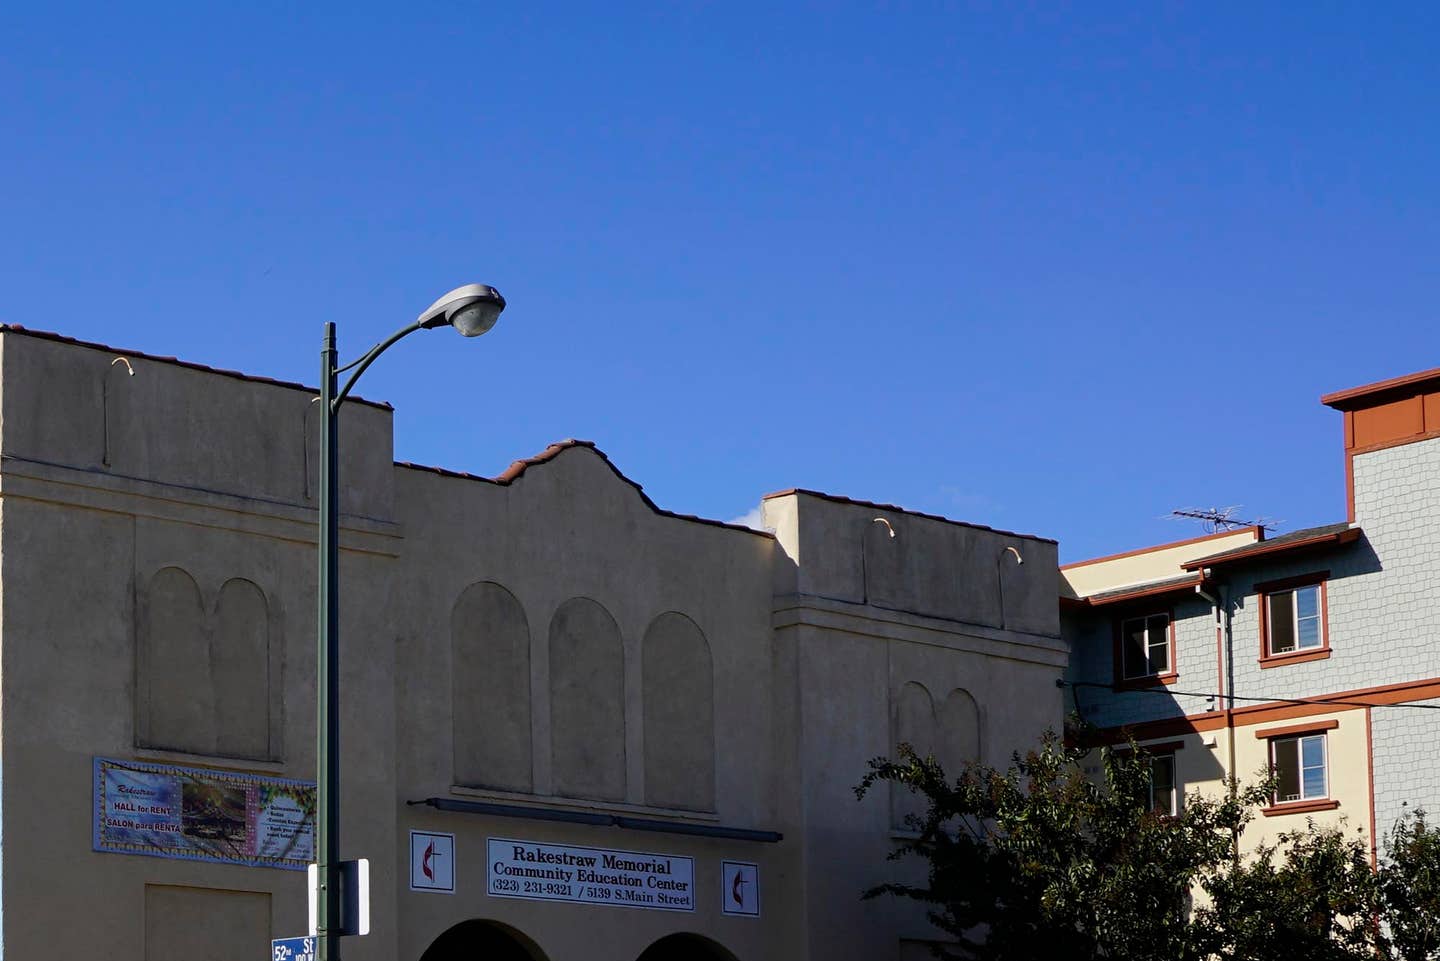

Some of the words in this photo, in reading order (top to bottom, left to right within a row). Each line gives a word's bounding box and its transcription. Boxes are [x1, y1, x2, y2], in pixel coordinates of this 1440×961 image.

[114, 802, 135, 812] HALL
[138, 805, 149, 813] for
[150, 806, 171, 815] RENT
[107, 818, 134, 828] SALON
[135, 822, 153, 831] para
[154, 823, 181, 833] RENTA
[513, 846, 596, 868] Rakestraw
[602, 854, 671, 875] Memorial
[493, 862, 573, 882] Community
[577, 869, 642, 888] Education
[647, 877, 689, 892] Center
[492, 878, 520, 893] (323)
[523, 881, 572, 897] 231-9321
[587, 886, 611, 899] 5139
[657, 892, 690, 906] Street
[274, 945, 292, 961] 52nd
[303, 938, 314, 954] St
